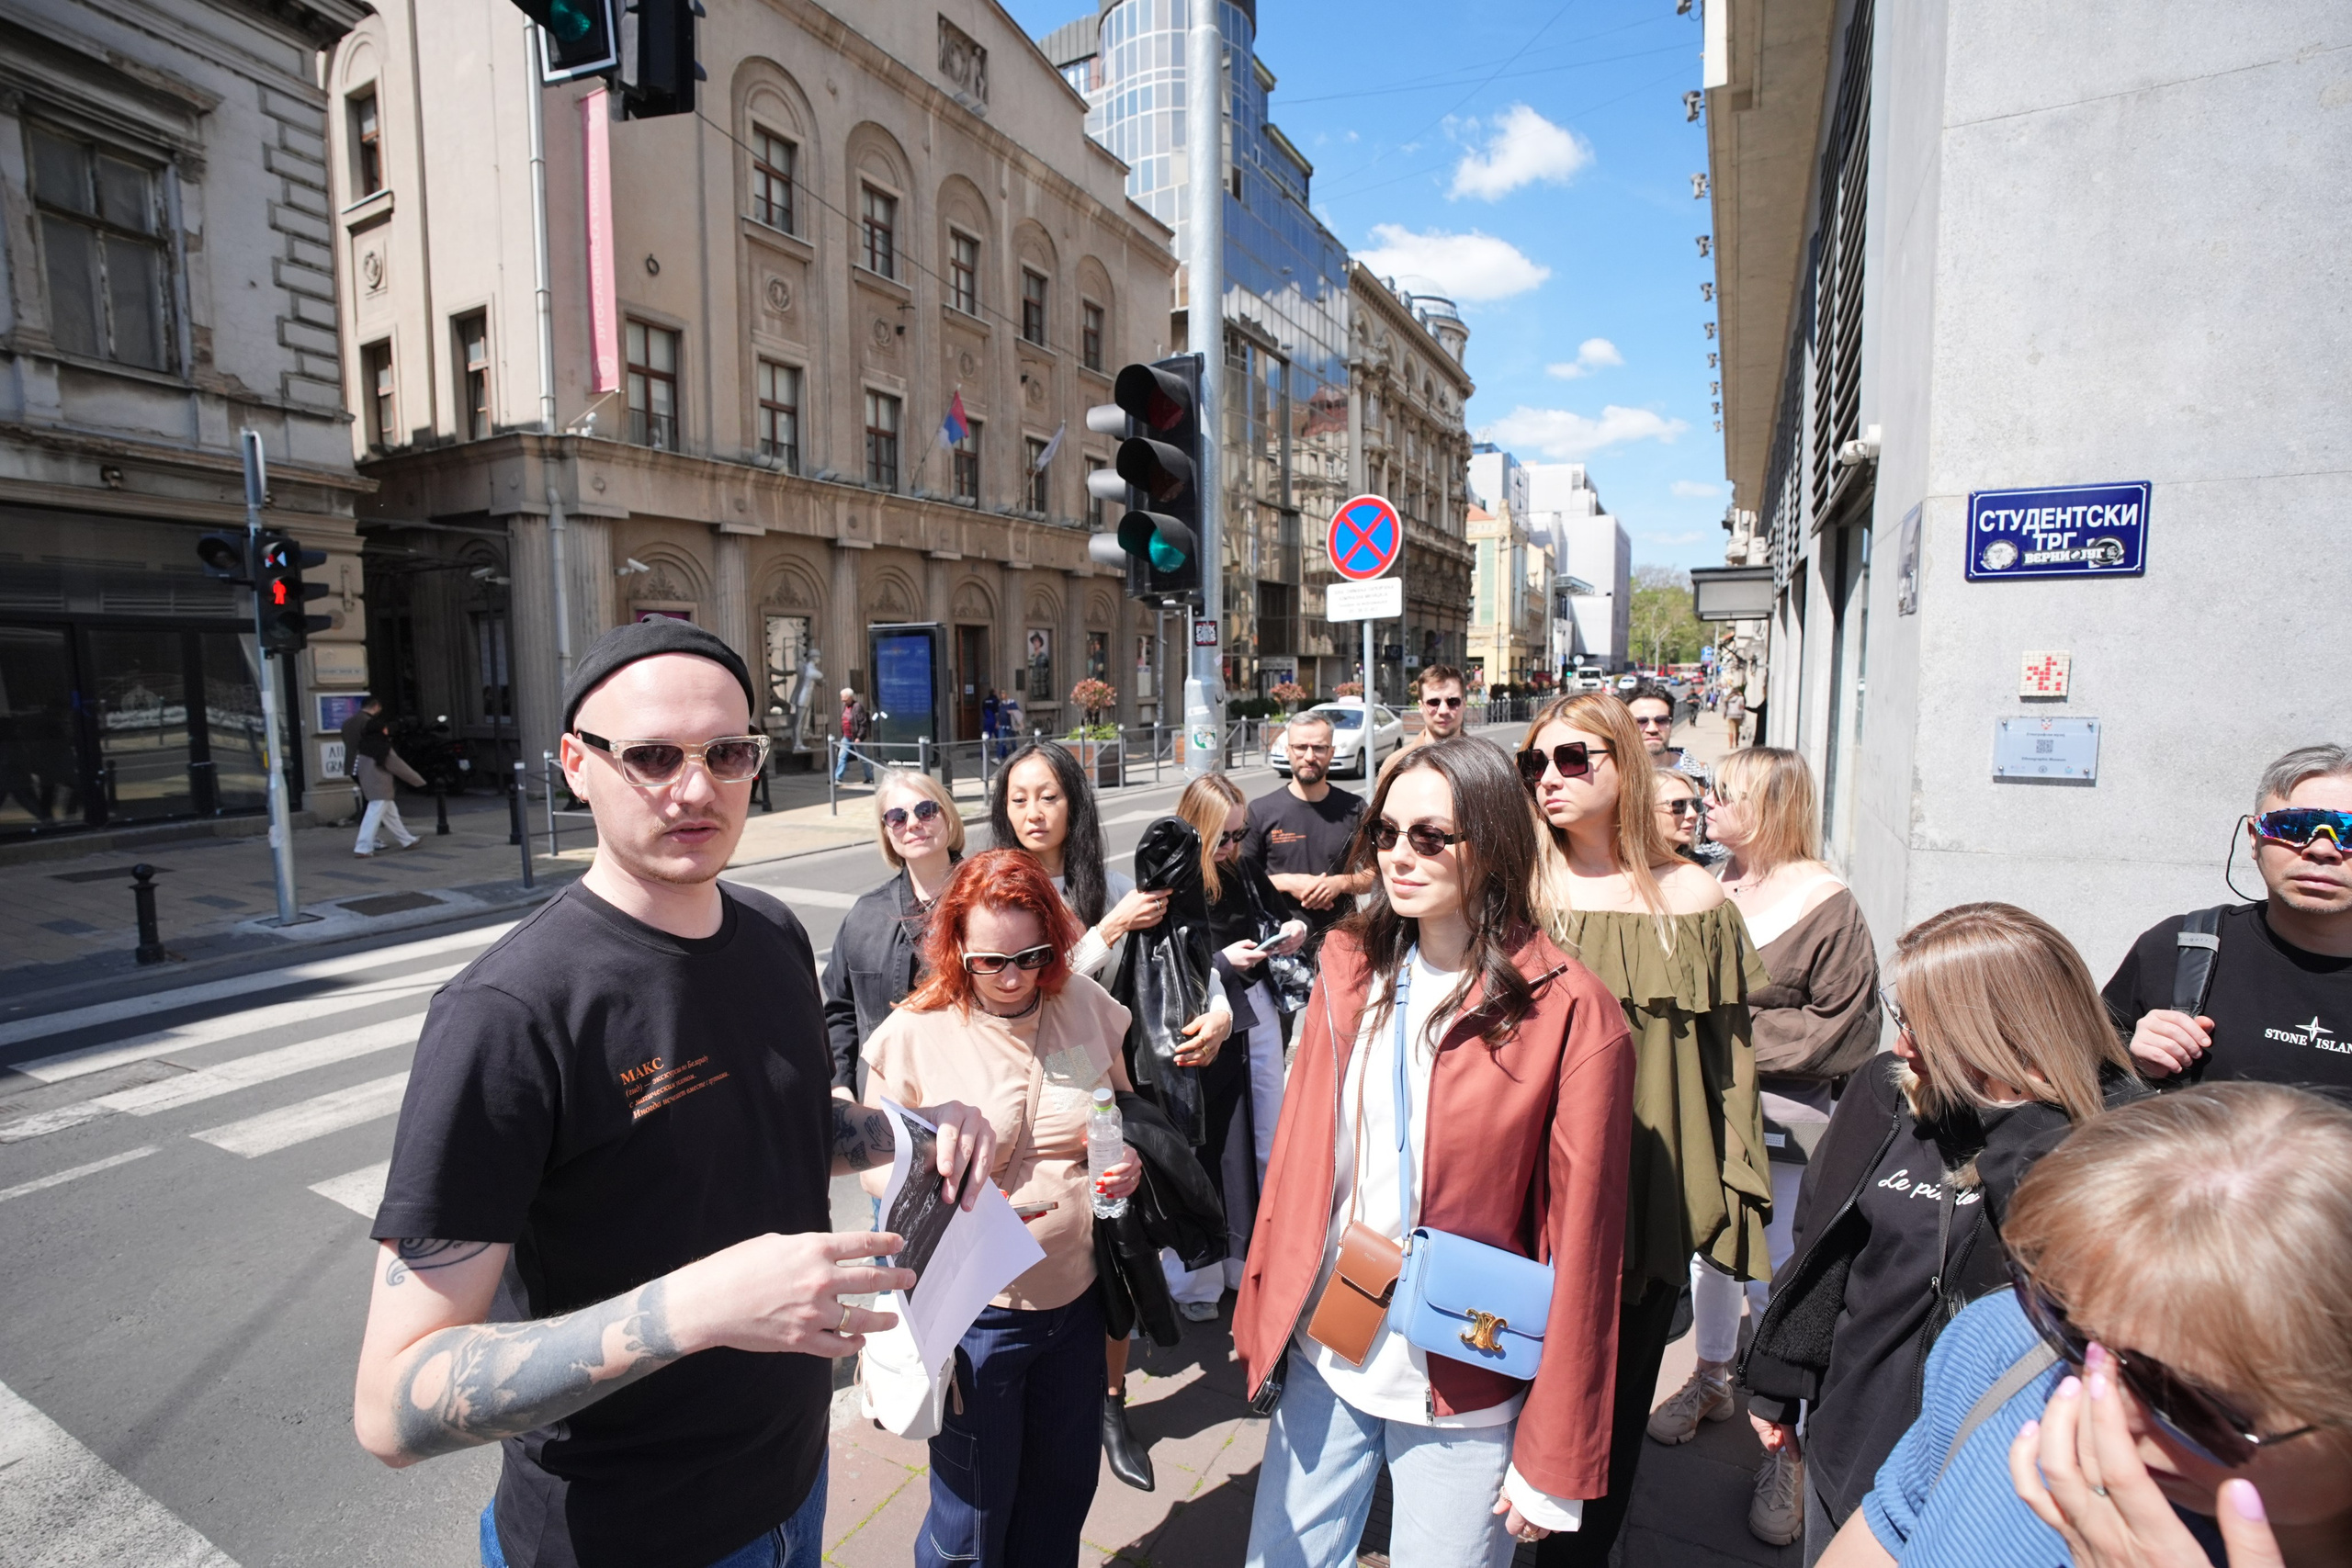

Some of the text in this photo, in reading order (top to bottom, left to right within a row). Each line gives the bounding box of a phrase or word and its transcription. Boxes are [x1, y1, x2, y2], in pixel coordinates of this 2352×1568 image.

[1978, 503, 2139, 536] СТУДЕНТСКИ
[2031, 531, 2077, 551] ТРГ
[2264, 1028, 2308, 1046] STONE
[619, 1056, 664, 1086] МАКС
[632, 1100, 662, 1120] Иногда
[1877, 1168, 1911, 1191] Le
